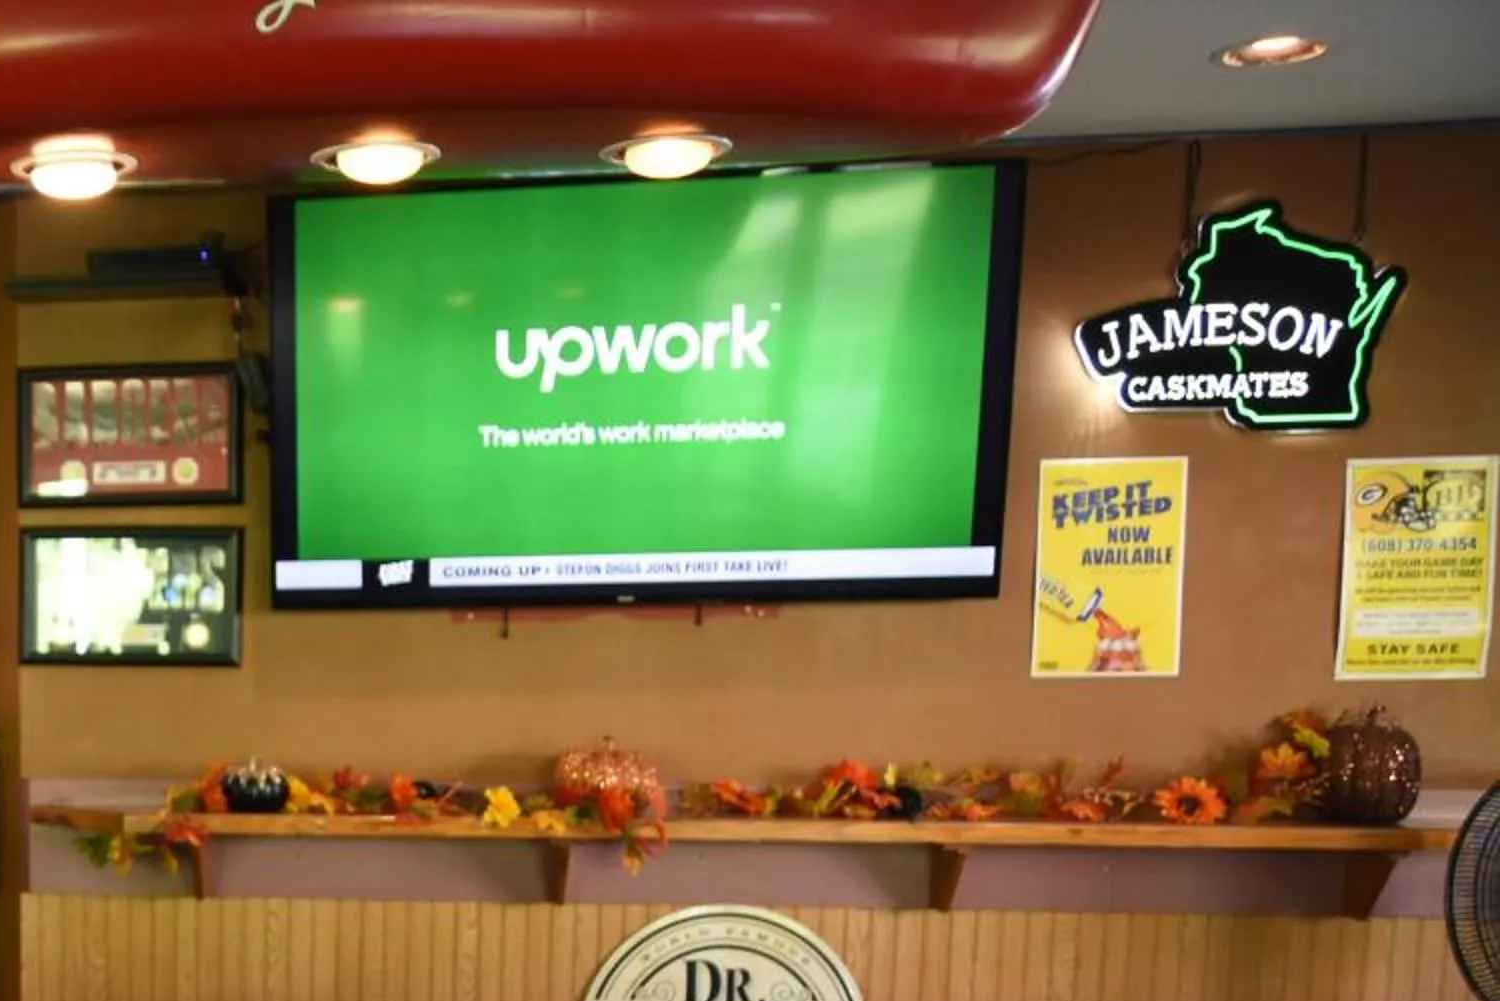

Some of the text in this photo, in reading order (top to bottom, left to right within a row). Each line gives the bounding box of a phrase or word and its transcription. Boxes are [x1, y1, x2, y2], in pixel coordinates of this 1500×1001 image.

[1097, 302, 1344, 368] JAMESON
[495, 303, 771, 393] upwork
[1127, 370, 1310, 402] CASKMATES
[478, 418, 786, 447] The world's work marketplace
[1052, 480, 1152, 512] KEEP IT
[1053, 497, 1172, 529] TWISTED
[1107, 527, 1150, 544] NOW
[556, 563, 601, 576] STEFON
[646, 561, 681, 575] JOINS
[685, 560, 719, 574] FIRST
[725, 560, 751, 573] TAKE
[1081, 547, 1173, 566] AVAILABLE
[442, 565, 542, 578] COMING UP
[1365, 571, 1393, 579] SAFE
[1395, 570, 1421, 579] AND
[1424, 570, 1448, 578] FUN
[1367, 643, 1460, 655] STAY SAFE
